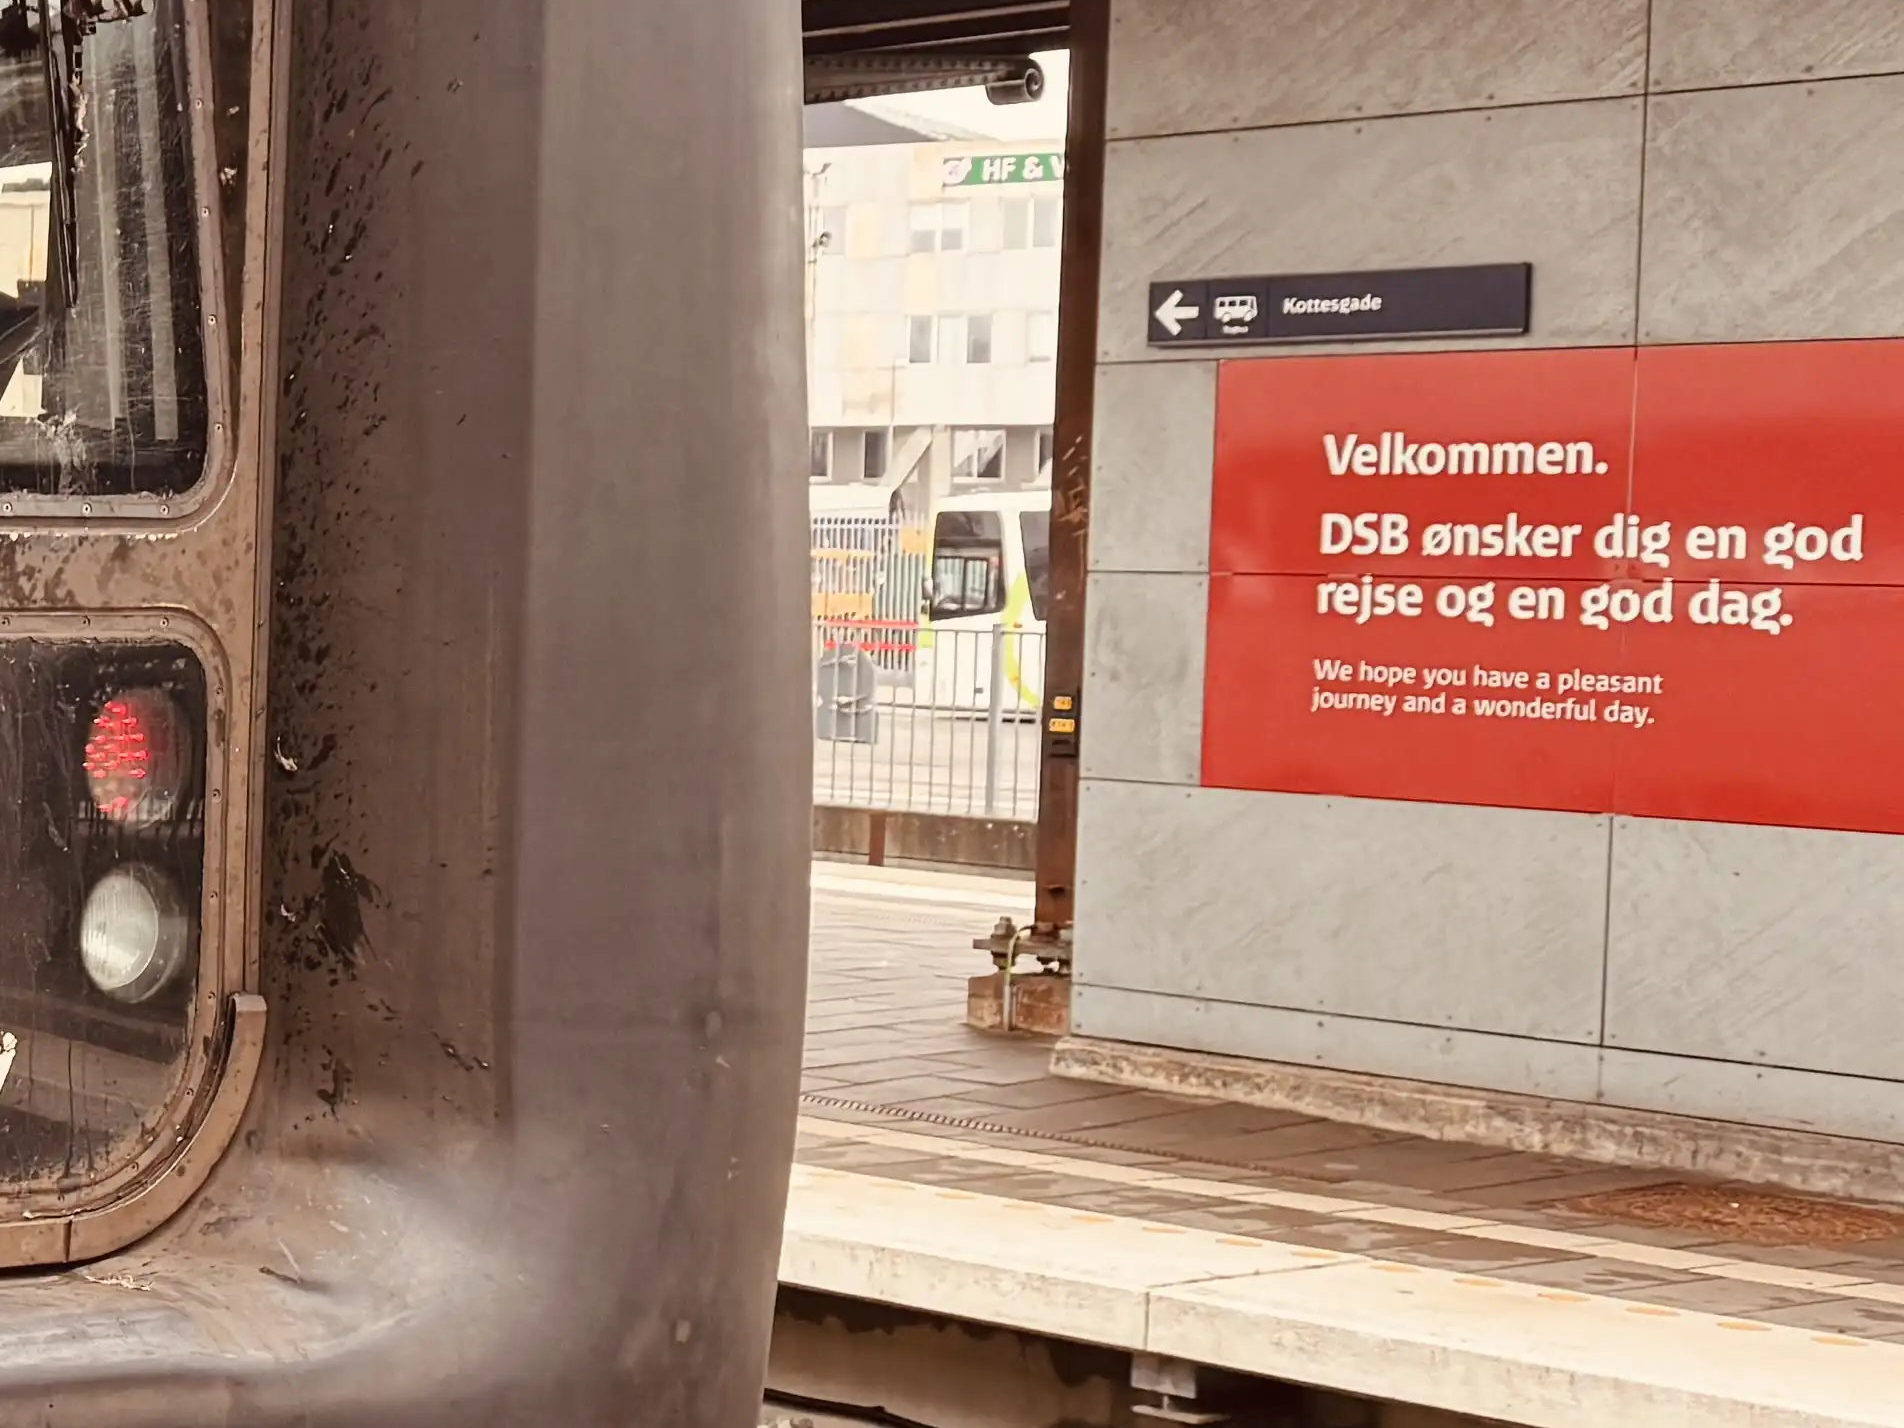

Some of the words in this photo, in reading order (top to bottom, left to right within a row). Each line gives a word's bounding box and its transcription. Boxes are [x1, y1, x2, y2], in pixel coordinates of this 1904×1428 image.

[982, 156, 1016, 181] HF
[1023, 156, 1043, 179] &
[1283, 293, 1382, 315] Kottesgade
[1323, 432, 1608, 476] Velkommen.
[1320, 513, 1408, 555] DSB
[1422, 514, 1581, 558] ønsker
[1594, 513, 1670, 568] dig
[1685, 523, 1747, 560] en
[1763, 515, 1864, 570] god
[1317, 575, 1423, 625] rejse
[1437, 582, 1495, 628] og
[1509, 586, 1564, 621] en
[1580, 577, 1673, 629] god
[1689, 578, 1793, 636] dag.
[1313, 659, 1353, 682] We
[1359, 660, 1417, 688] hope
[1423, 666, 1467, 689] you
[1473, 665, 1529, 689] have
[1535, 671, 1551, 690] a
[1557, 669, 1663, 695] pleasant
[1311, 687, 1396, 716] journey
[1403, 691, 1446, 714] and
[1452, 698, 1467, 715] a
[1473, 696, 1597, 721] wonderful
[1604, 702, 1656, 728] day.
